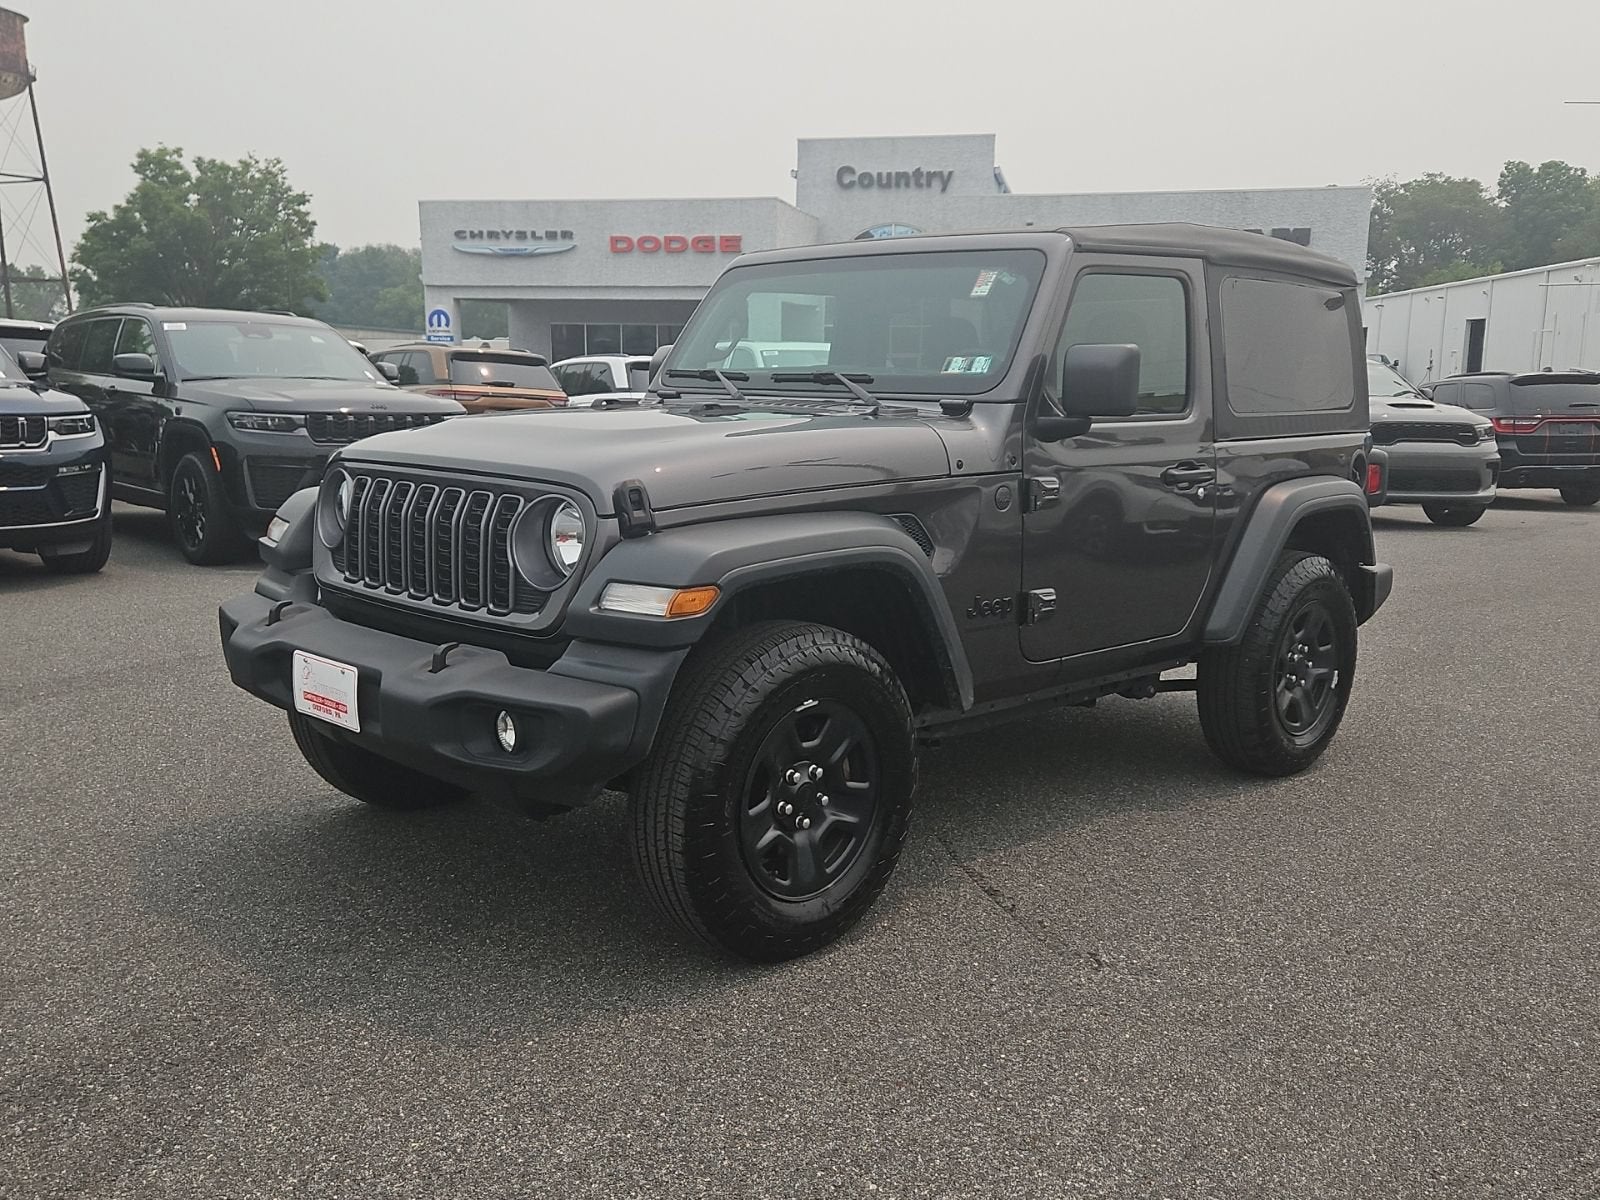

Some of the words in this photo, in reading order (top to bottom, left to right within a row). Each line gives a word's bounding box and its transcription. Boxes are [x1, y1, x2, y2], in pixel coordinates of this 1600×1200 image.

[836, 165, 954, 193] Country
[454, 230, 574, 240] CHRYSLER
[609, 235, 742, 253] DODGE
[967, 594, 1013, 619] Jeep
